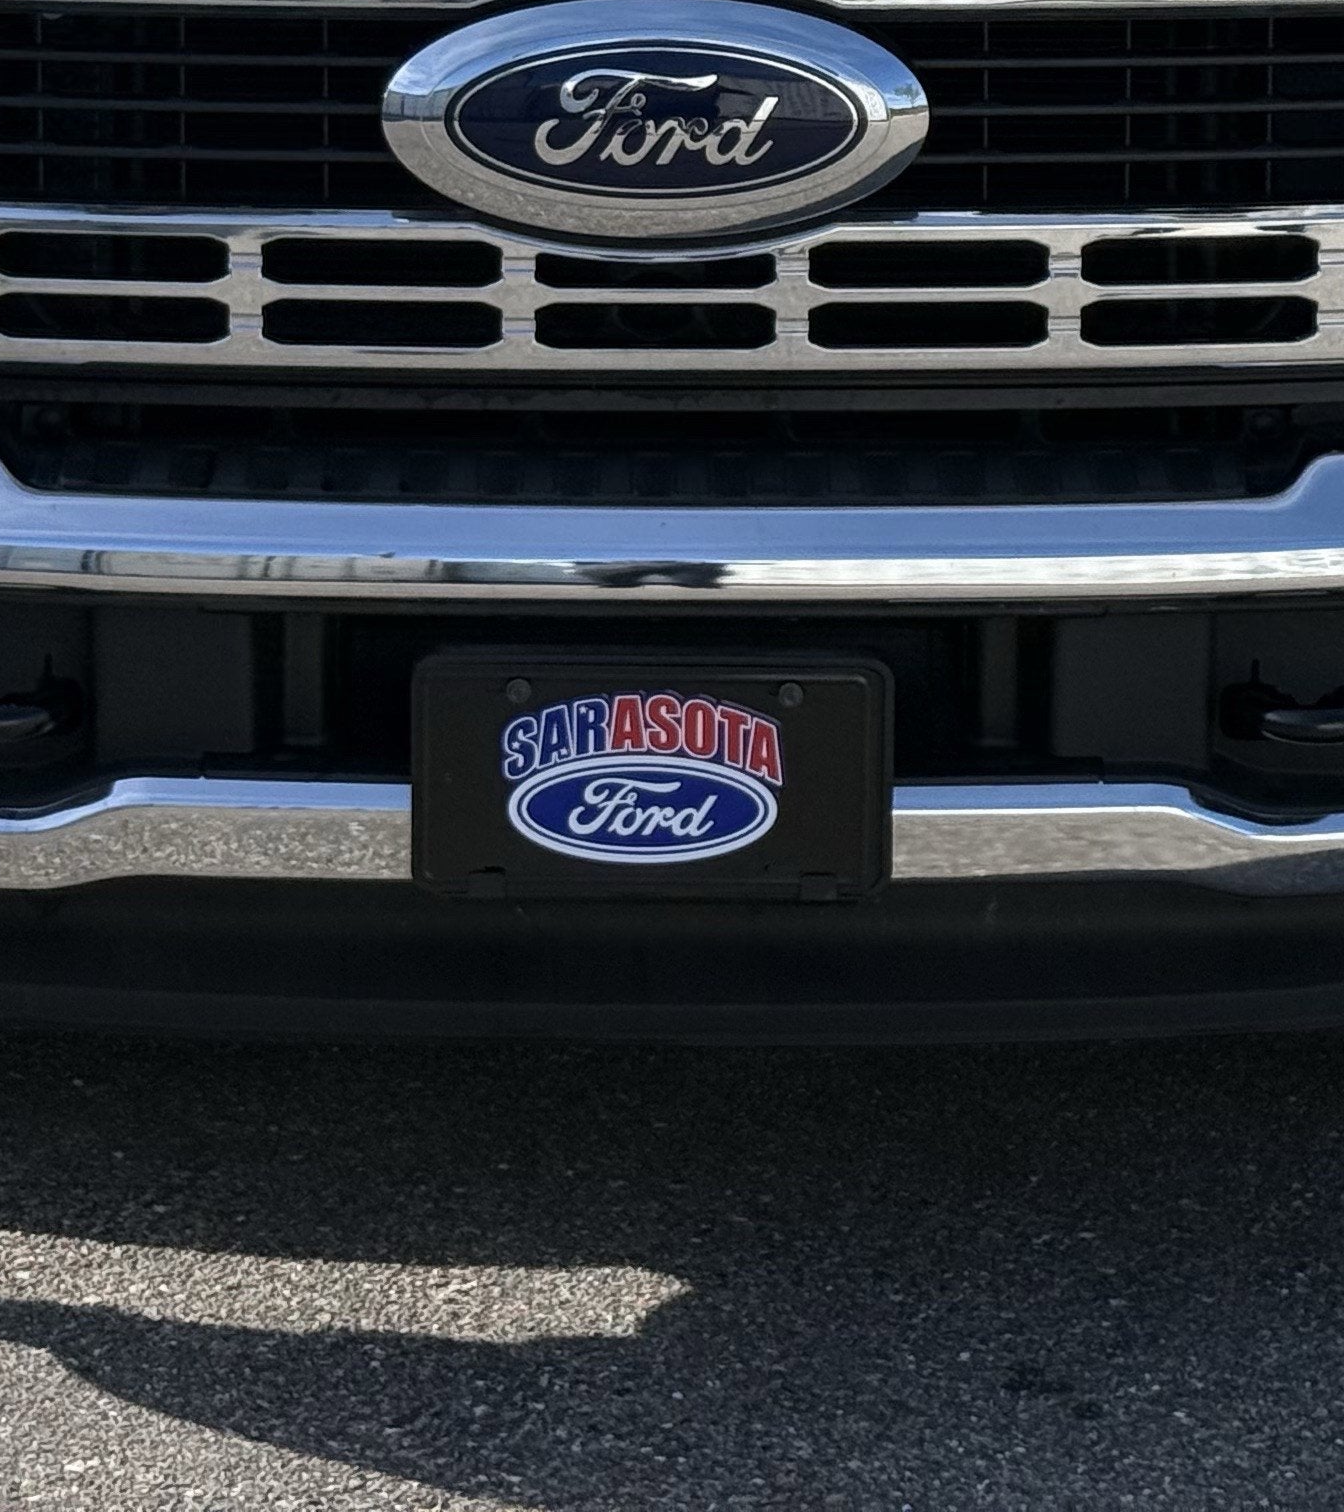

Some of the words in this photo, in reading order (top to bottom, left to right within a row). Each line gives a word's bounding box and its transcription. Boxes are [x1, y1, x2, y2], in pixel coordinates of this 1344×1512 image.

[534, 68, 777, 167] Ford
[504, 694, 783, 786] SARASOTA
[568, 777, 720, 837] Ford
